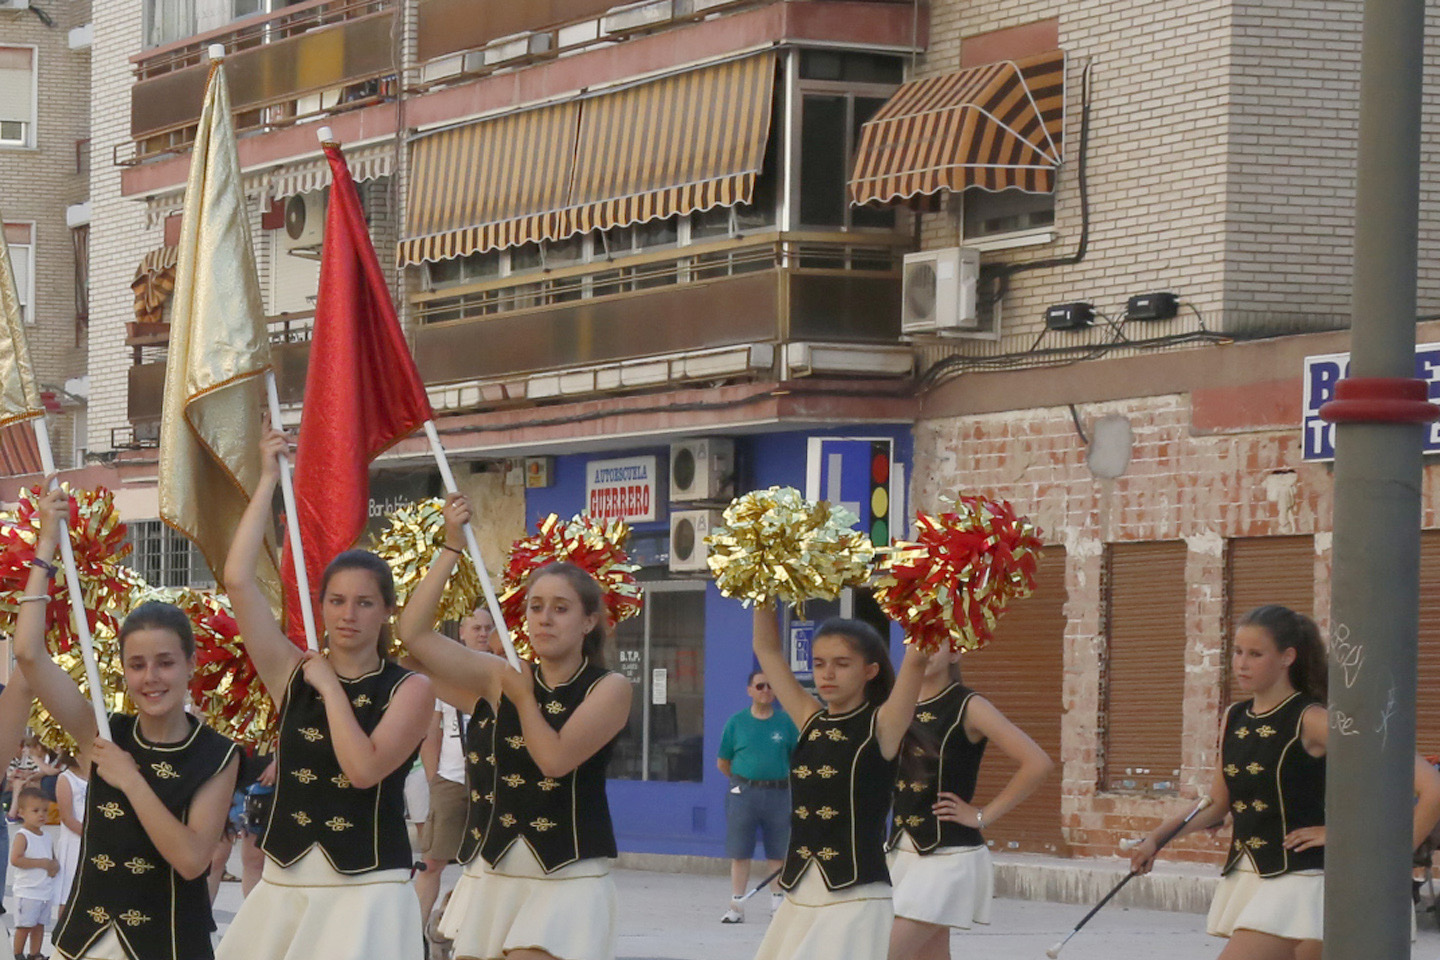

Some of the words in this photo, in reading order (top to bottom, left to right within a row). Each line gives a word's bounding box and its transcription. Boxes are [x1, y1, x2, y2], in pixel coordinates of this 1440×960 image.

[594, 465, 648, 483] AUTOESCUELA
[368, 498, 384, 518] Bar
[590, 484, 650, 519] GUERRERO
